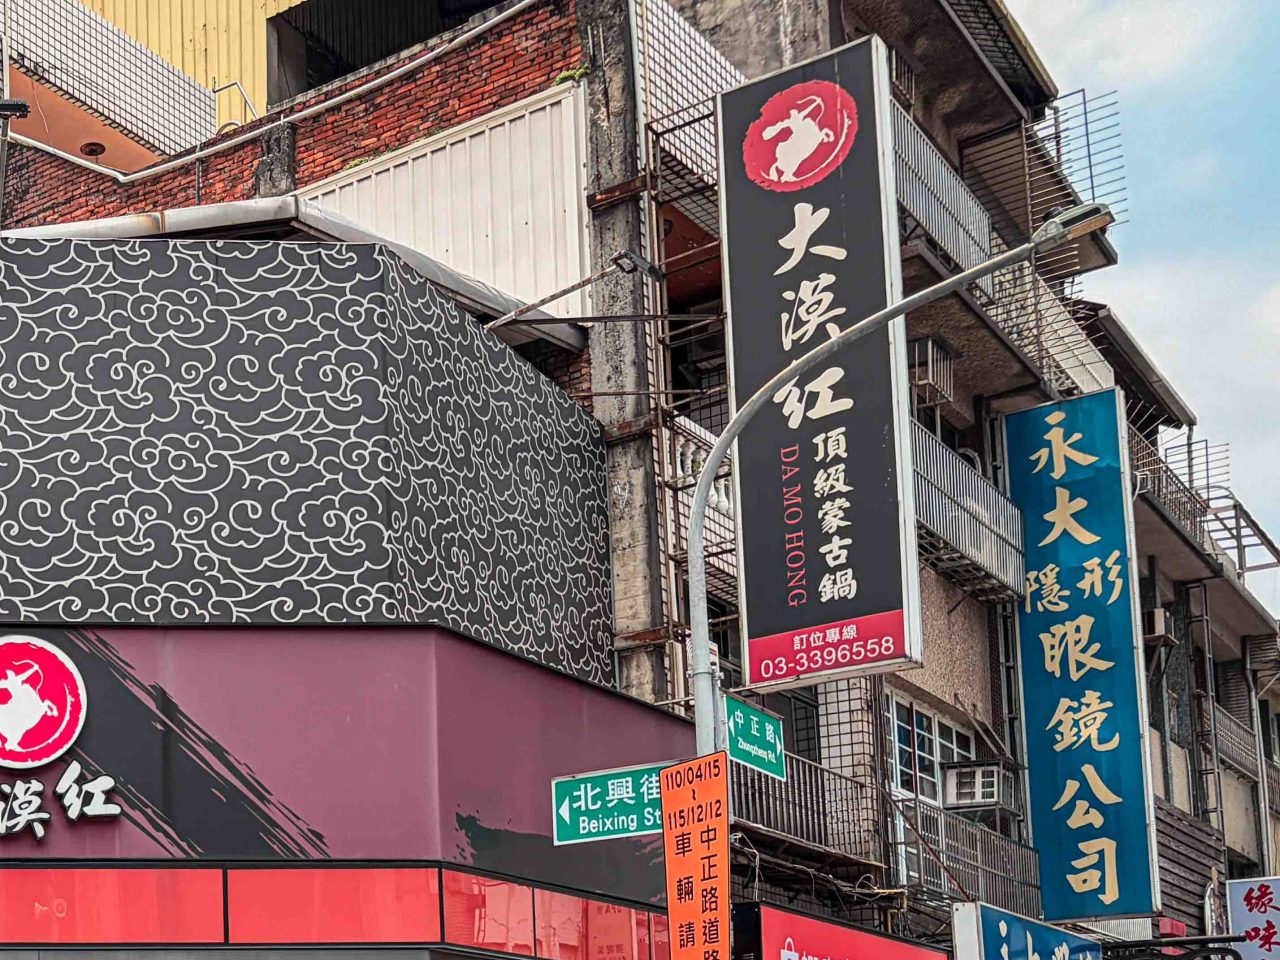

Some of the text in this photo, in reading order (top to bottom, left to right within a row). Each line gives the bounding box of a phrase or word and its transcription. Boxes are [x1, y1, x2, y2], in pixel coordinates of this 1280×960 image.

[773, 202, 854, 429] 大漠紅
[782, 483, 803, 525] MO
[811, 426, 858, 603] 頂級蒙古鍋
[784, 529, 808, 608] HONG
[792, 624, 858, 651] 訂位專線
[760, 636, 895, 678] 03-3396558
[734, 709, 775, 744] 中正路
[665, 759, 721, 791] 110/04/15
[578, 813, 638, 835] Beixing
[668, 799, 722, 830] 115/12/12
